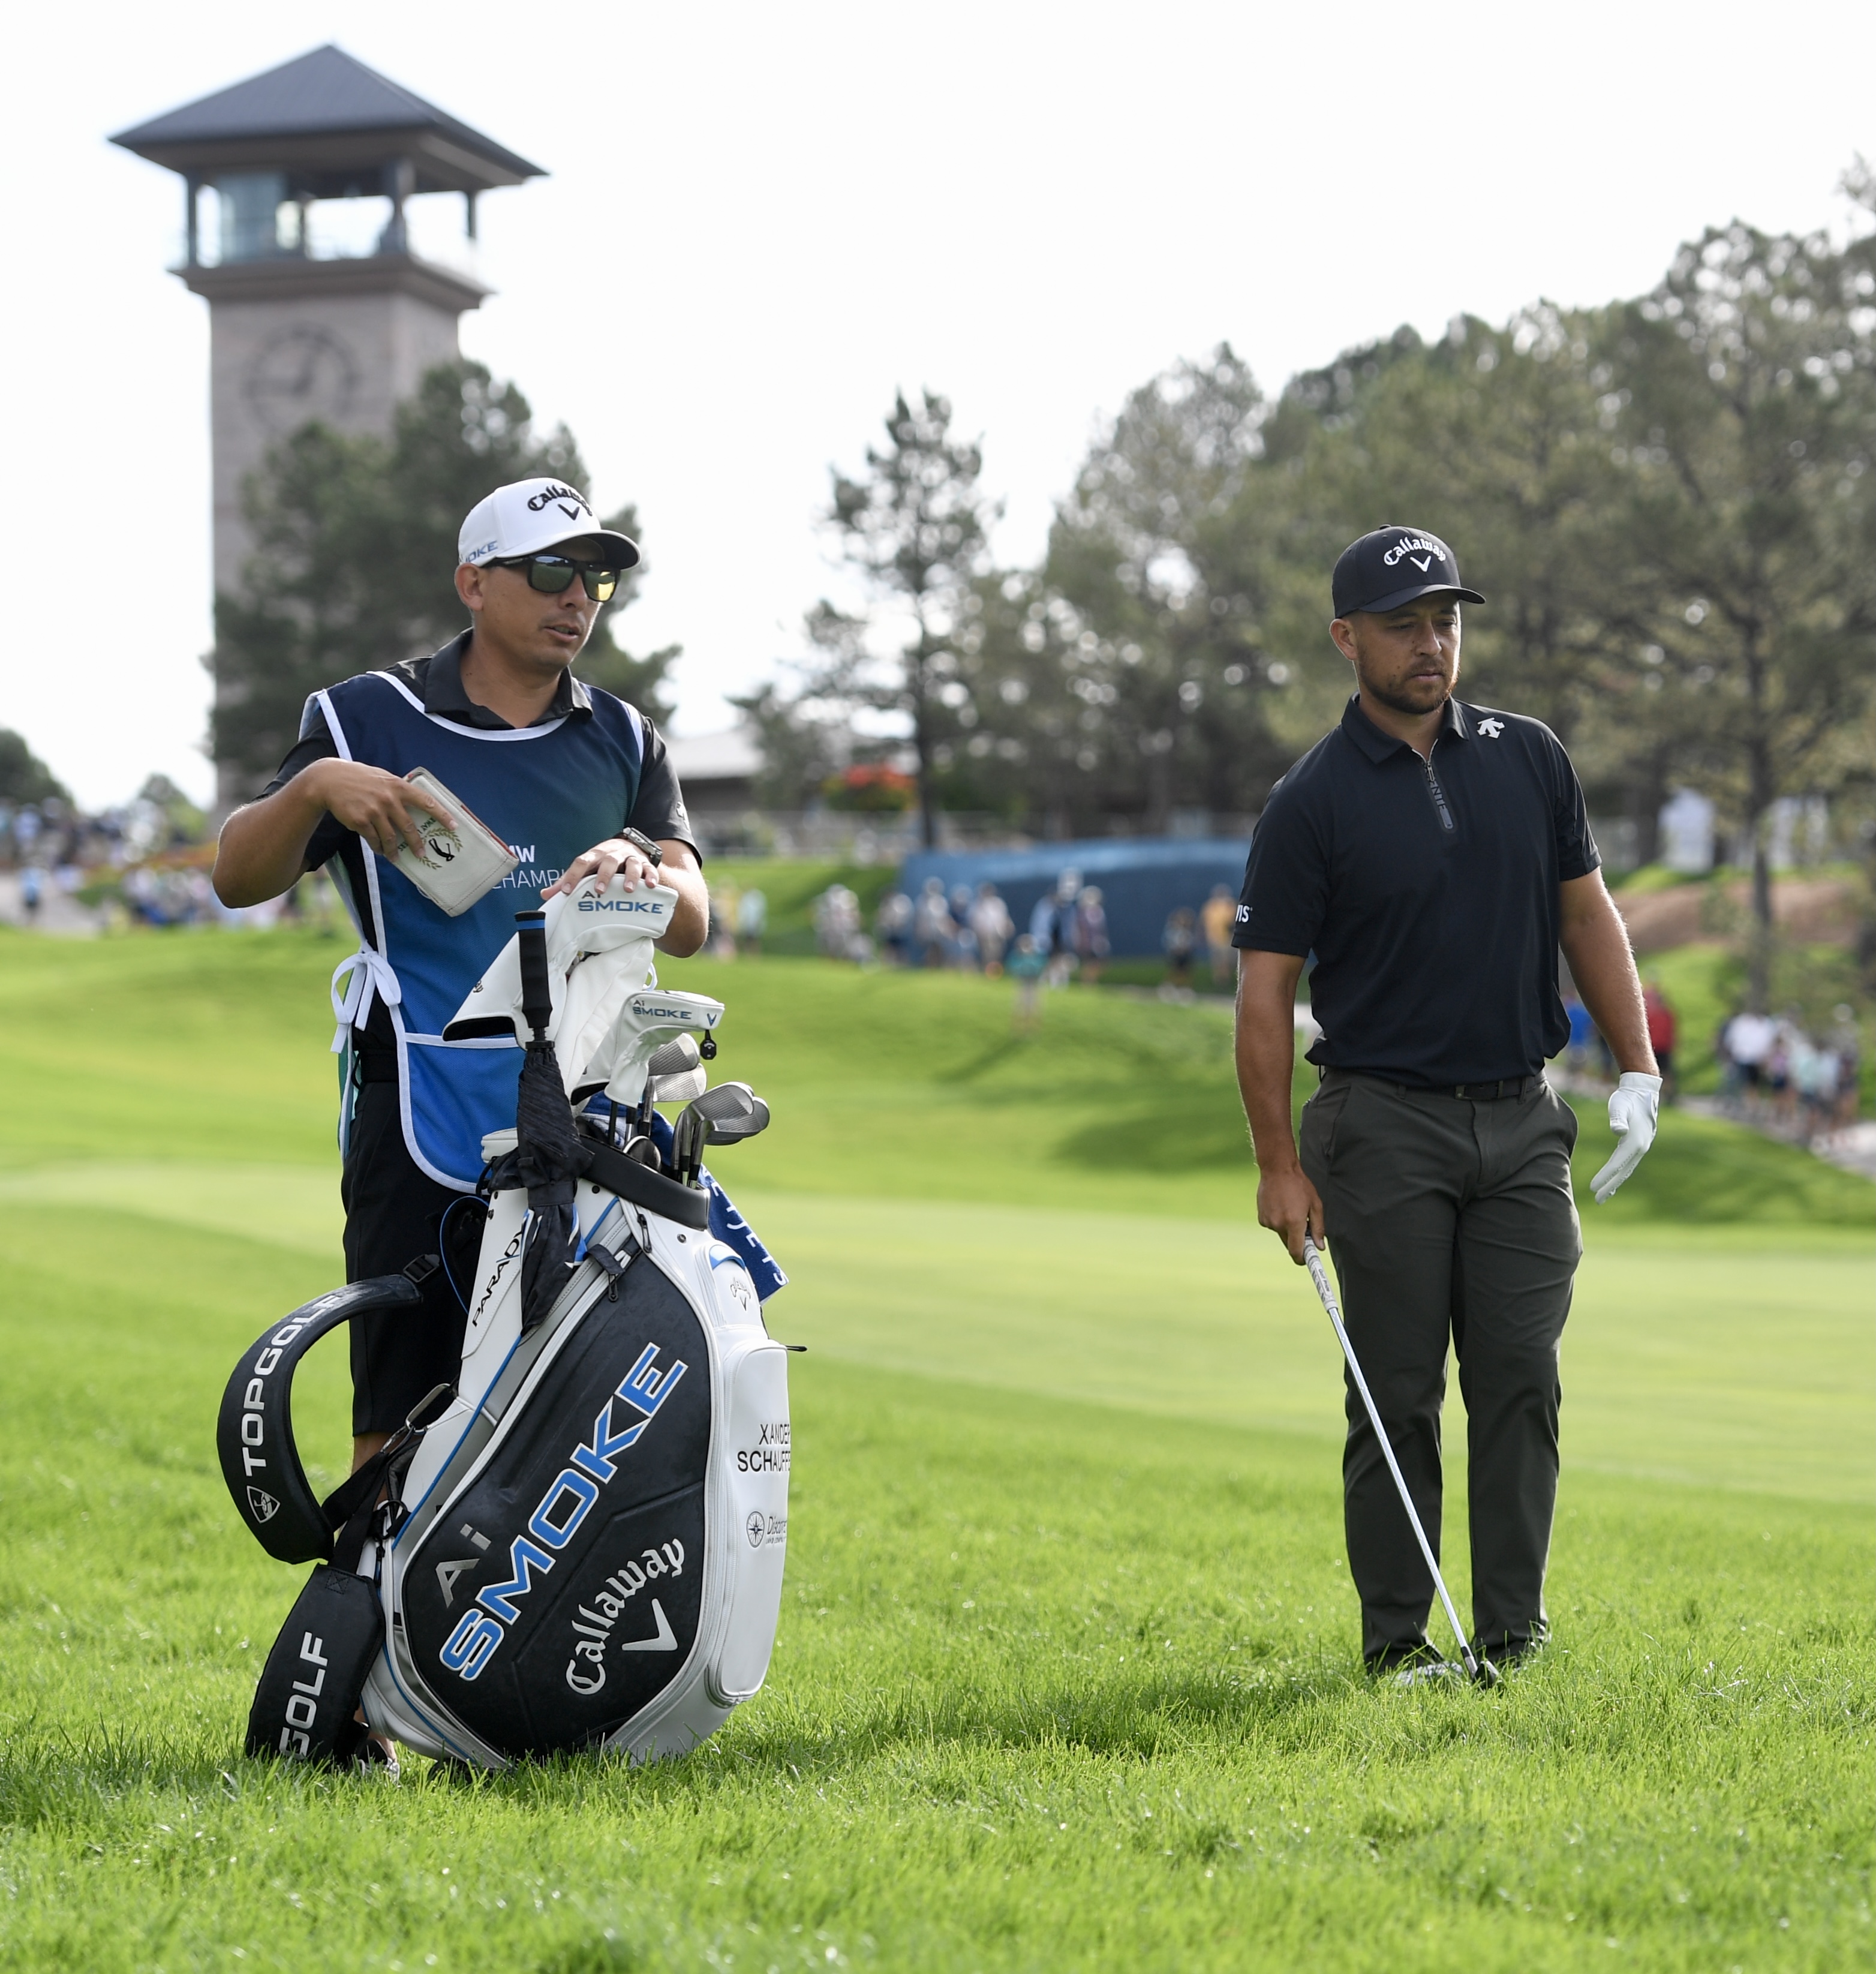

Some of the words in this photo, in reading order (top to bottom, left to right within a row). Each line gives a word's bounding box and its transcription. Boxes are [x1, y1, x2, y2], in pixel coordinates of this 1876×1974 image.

[527, 484, 593, 517] Callaway
[466, 540, 498, 563] OKE
[1384, 536, 1446, 566] Callaway
[492, 869, 565, 889] HAMP
[578, 900, 663, 914] SMOKE
[633, 1006, 692, 1020] SMOKE
[473, 1230, 522, 1327] PARAD
[242, 1295, 341, 1477] TOPGOLF
[439, 1342, 689, 1681] SMOKE
[435, 1524, 492, 1608] Ai
[566, 1539, 685, 1695] Callaway
